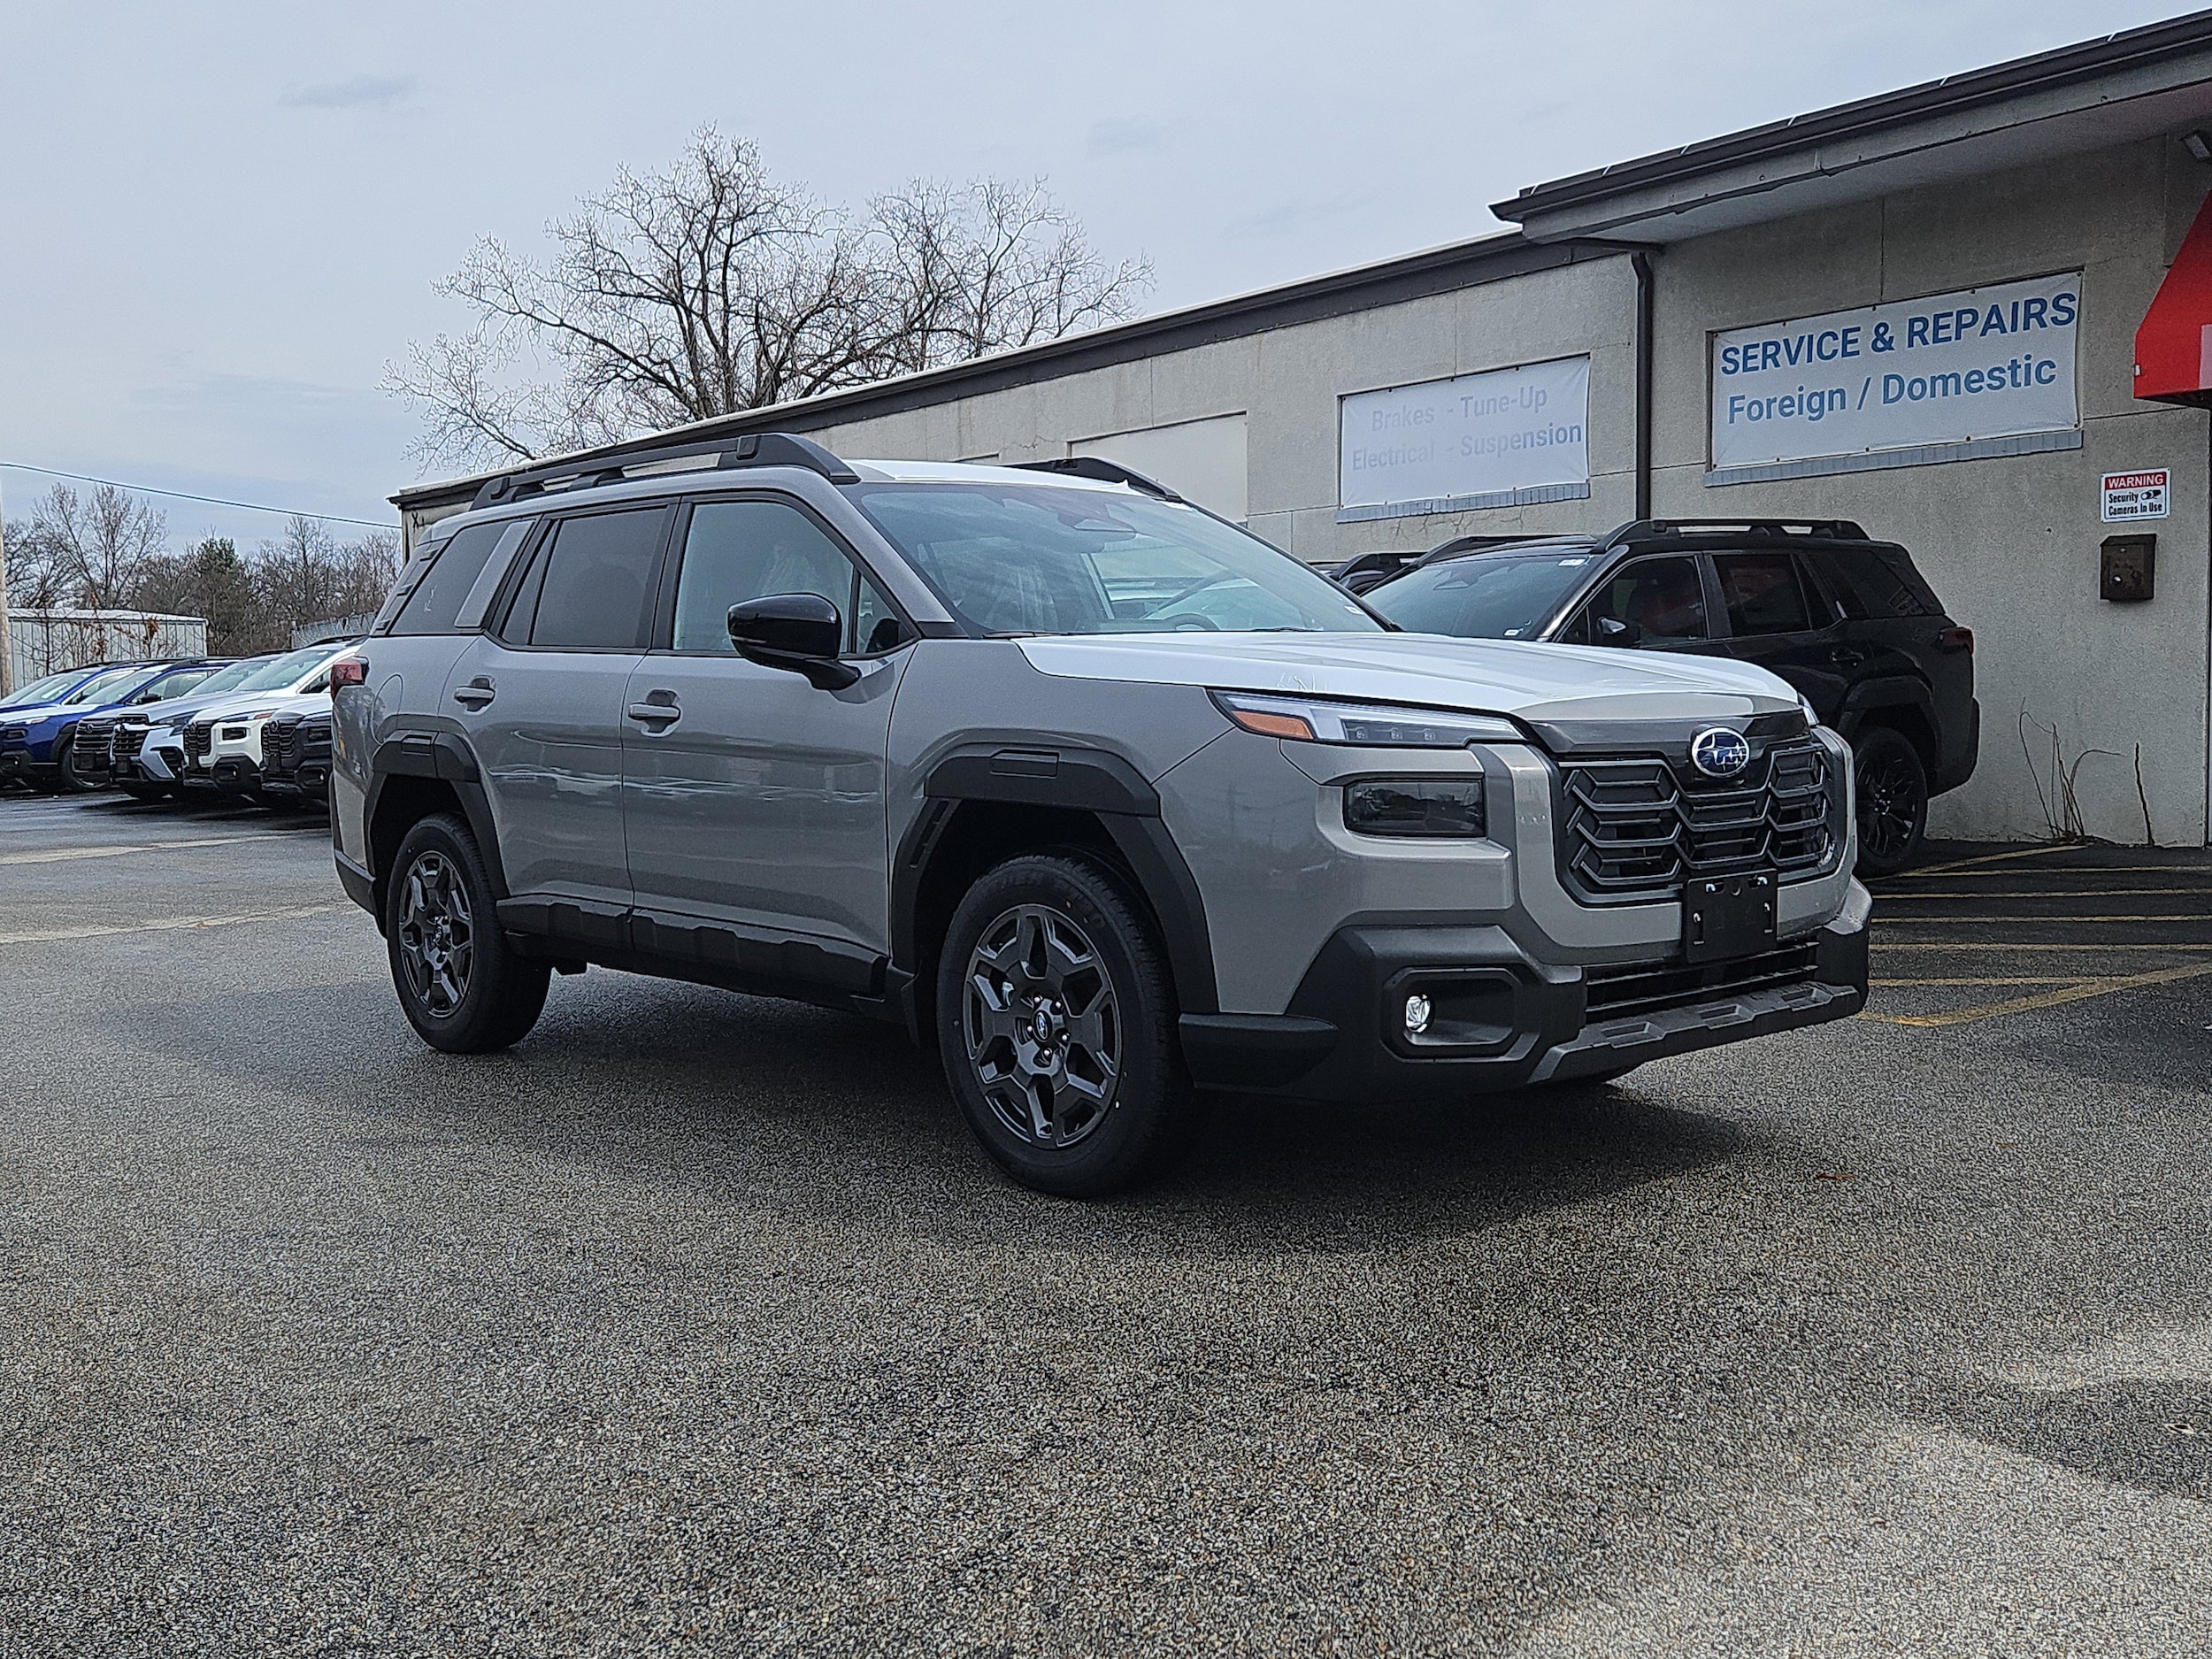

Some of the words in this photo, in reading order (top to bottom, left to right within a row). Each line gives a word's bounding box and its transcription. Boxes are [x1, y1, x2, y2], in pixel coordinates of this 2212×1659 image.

[1721, 325, 1862, 375] SERVICE
[1872, 321, 1894, 352] &
[1907, 292, 2077, 349] REPAIRS
[1371, 404, 1435, 432] Brakes
[1460, 386, 1547, 418] Tune-Up
[1728, 385, 1847, 425] Foreign
[1856, 377, 1872, 411] /
[1882, 353, 2057, 404] Domestic
[1352, 442, 1434, 471] Electrical
[1461, 422, 1582, 457] Suspension
[2108, 474, 2163, 488] WARNING
[2108, 491, 2139, 503] Security
[2108, 504, 2139, 516] Cameras
[2140, 503, 2147, 513] In
[2149, 503, 2162, 512] Use
